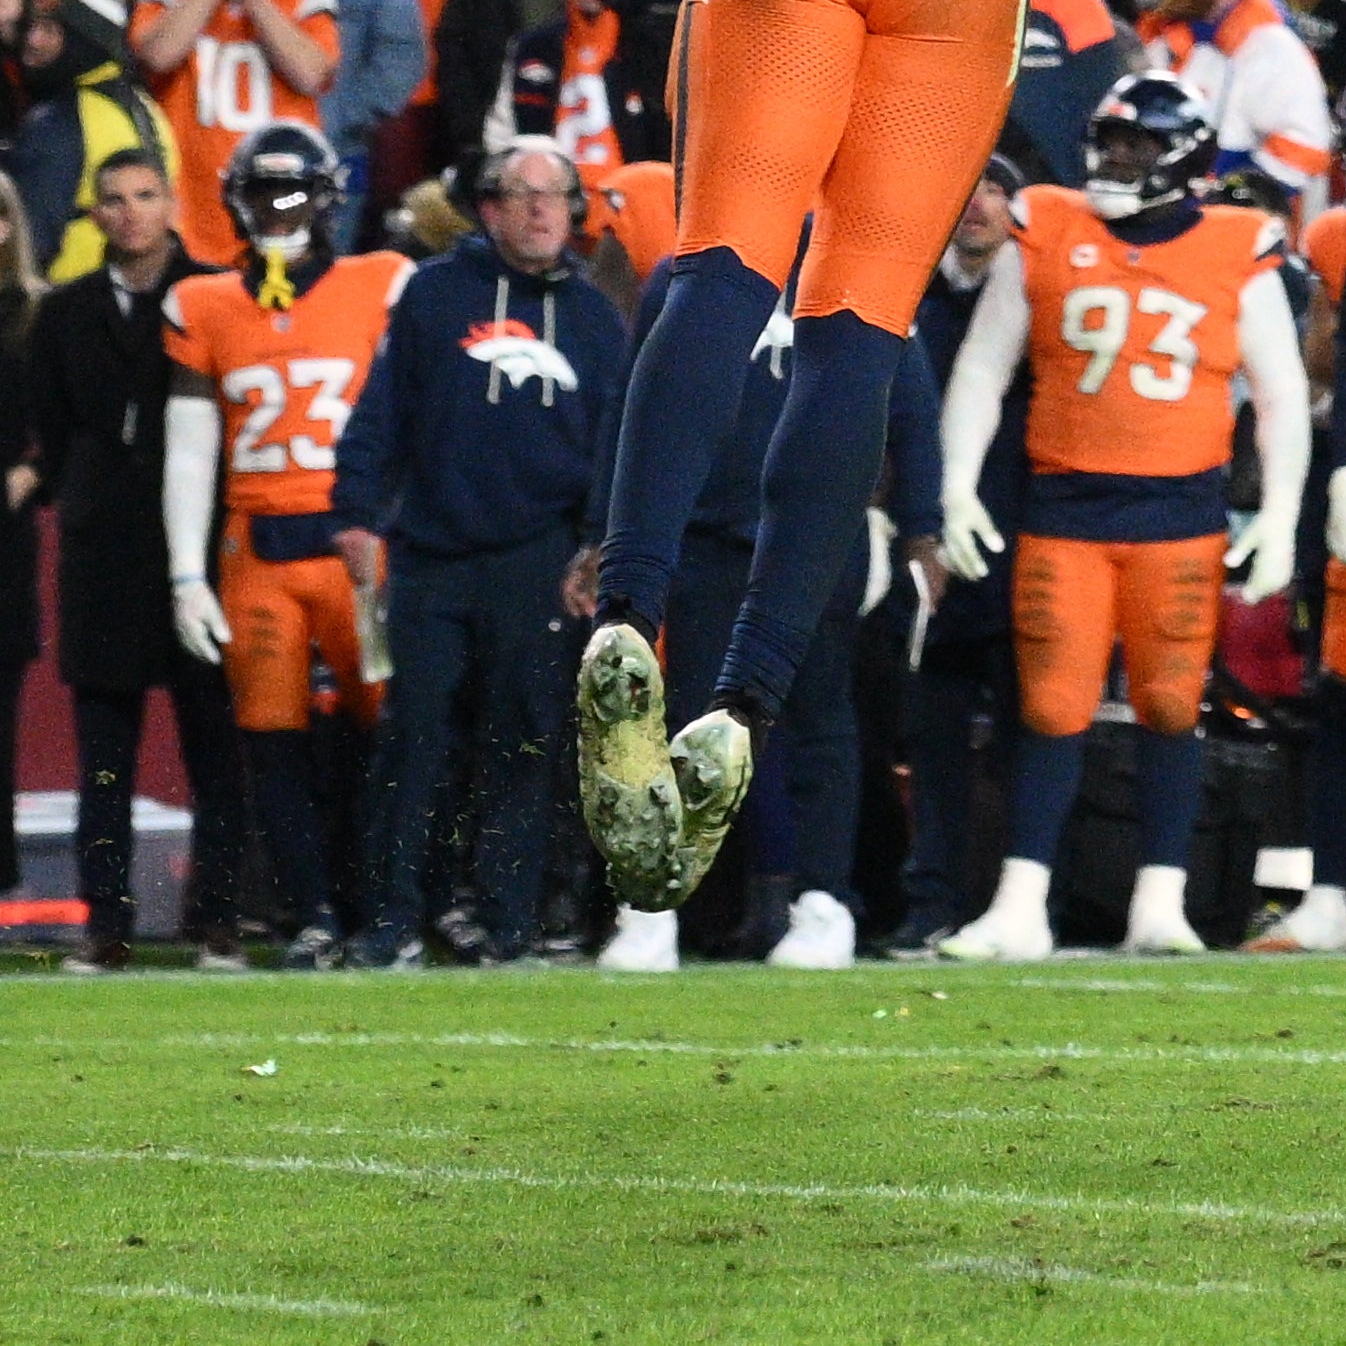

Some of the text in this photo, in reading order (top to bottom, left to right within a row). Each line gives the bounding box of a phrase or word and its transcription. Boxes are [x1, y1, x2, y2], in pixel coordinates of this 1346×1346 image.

[197, 37, 273, 131] 10
[1060, 283, 1210, 402] 93
[221, 357, 357, 473] 23
